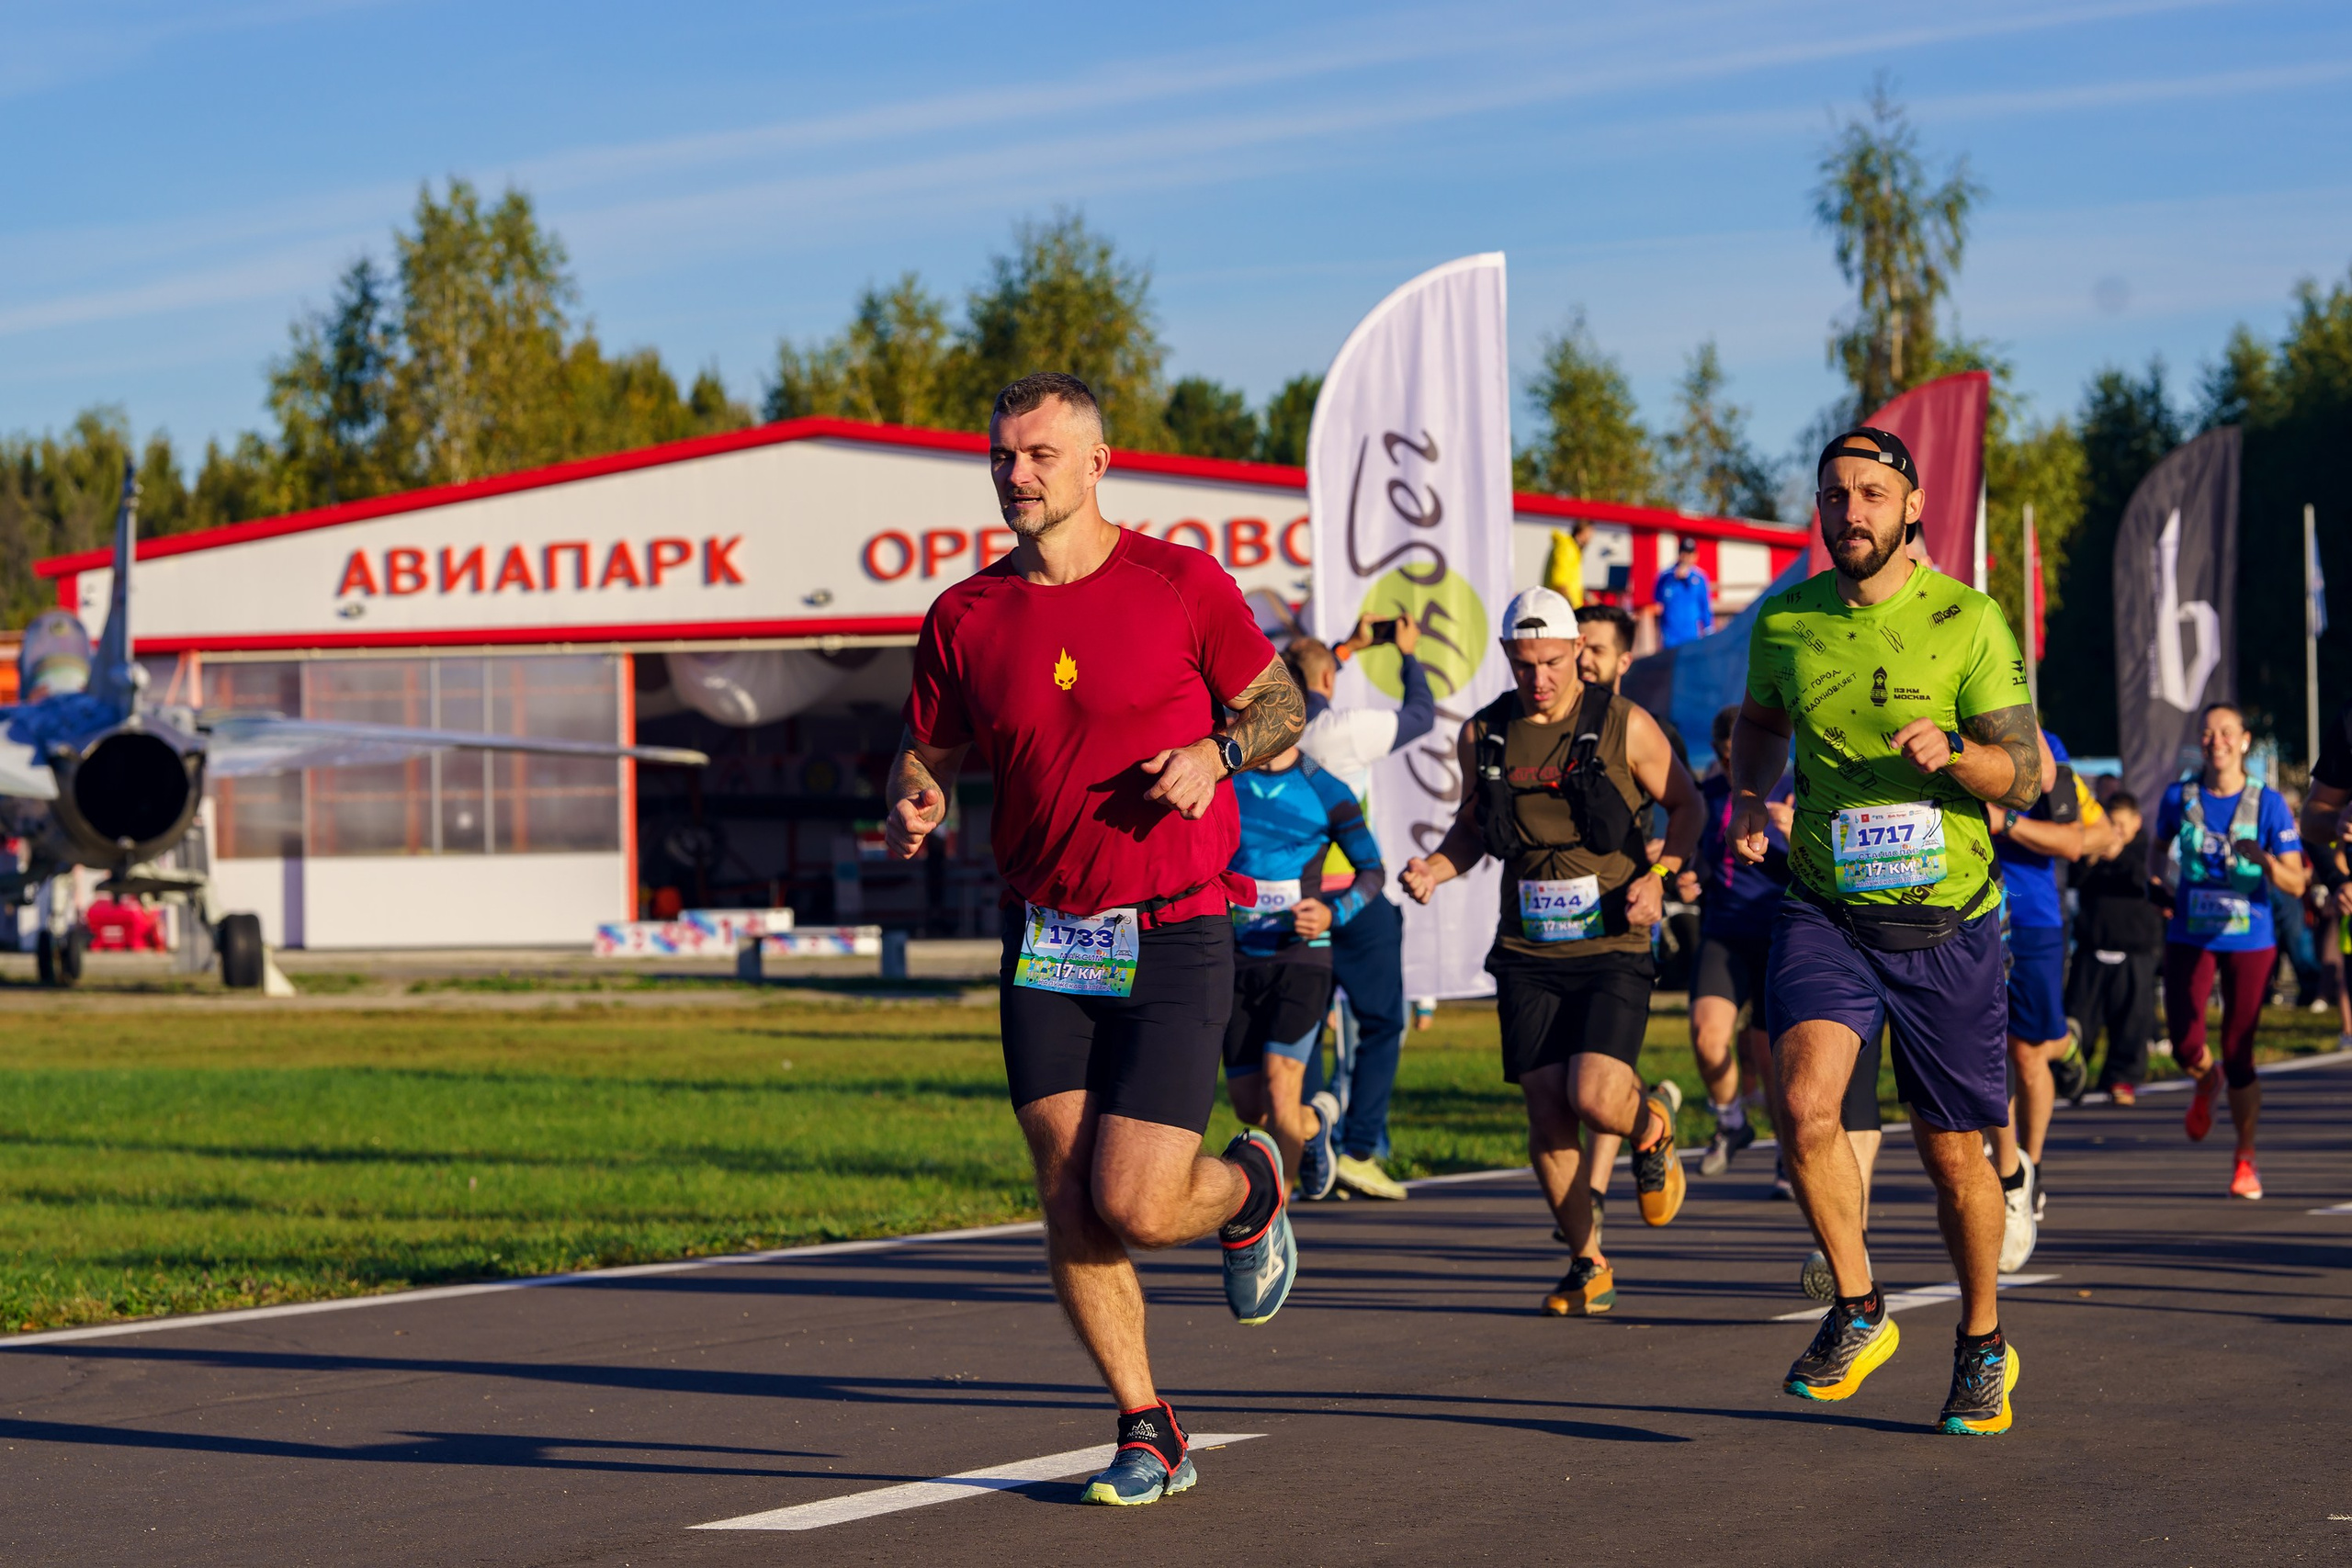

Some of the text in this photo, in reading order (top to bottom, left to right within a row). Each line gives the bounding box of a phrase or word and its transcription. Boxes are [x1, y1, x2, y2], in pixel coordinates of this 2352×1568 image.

[334, 535, 744, 598] АВИАПАРК
[1804, 671, 1858, 714] ВДОХНОВЛЯЕТ
[1857, 823, 1916, 847] 1717
[1858, 847, 1919, 860] СТАНИСЛАВ
[1865, 861, 1914, 877] 17 КМ
[1532, 895, 1582, 909] 1744
[1048, 924, 1115, 949] 1733
[1058, 952, 1103, 963] МАКСИМ
[1055, 962, 1103, 982] 17 КМ
[1037, 978, 1082, 991] КАЛУЖСКАЯ
